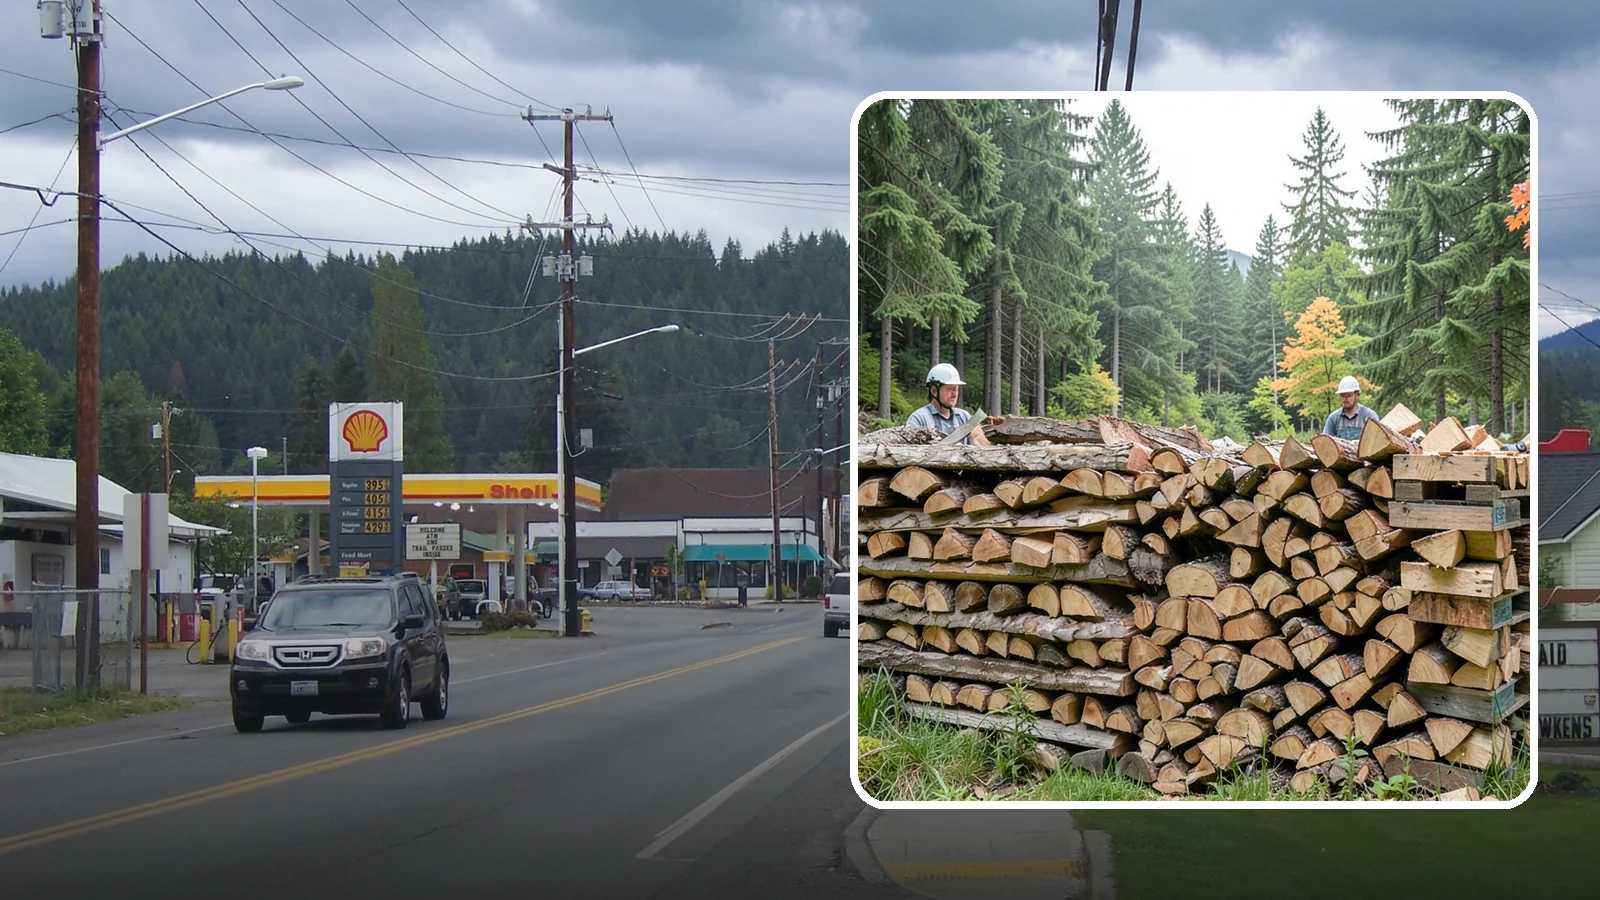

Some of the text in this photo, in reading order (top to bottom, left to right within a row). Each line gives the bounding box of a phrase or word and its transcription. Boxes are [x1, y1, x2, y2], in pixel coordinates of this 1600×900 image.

[366, 479, 383, 490] 395
[490, 484, 547, 499] Shell
[366, 494, 383, 504] 405
[366, 508, 383, 518] 415
[366, 522, 383, 532] 429
